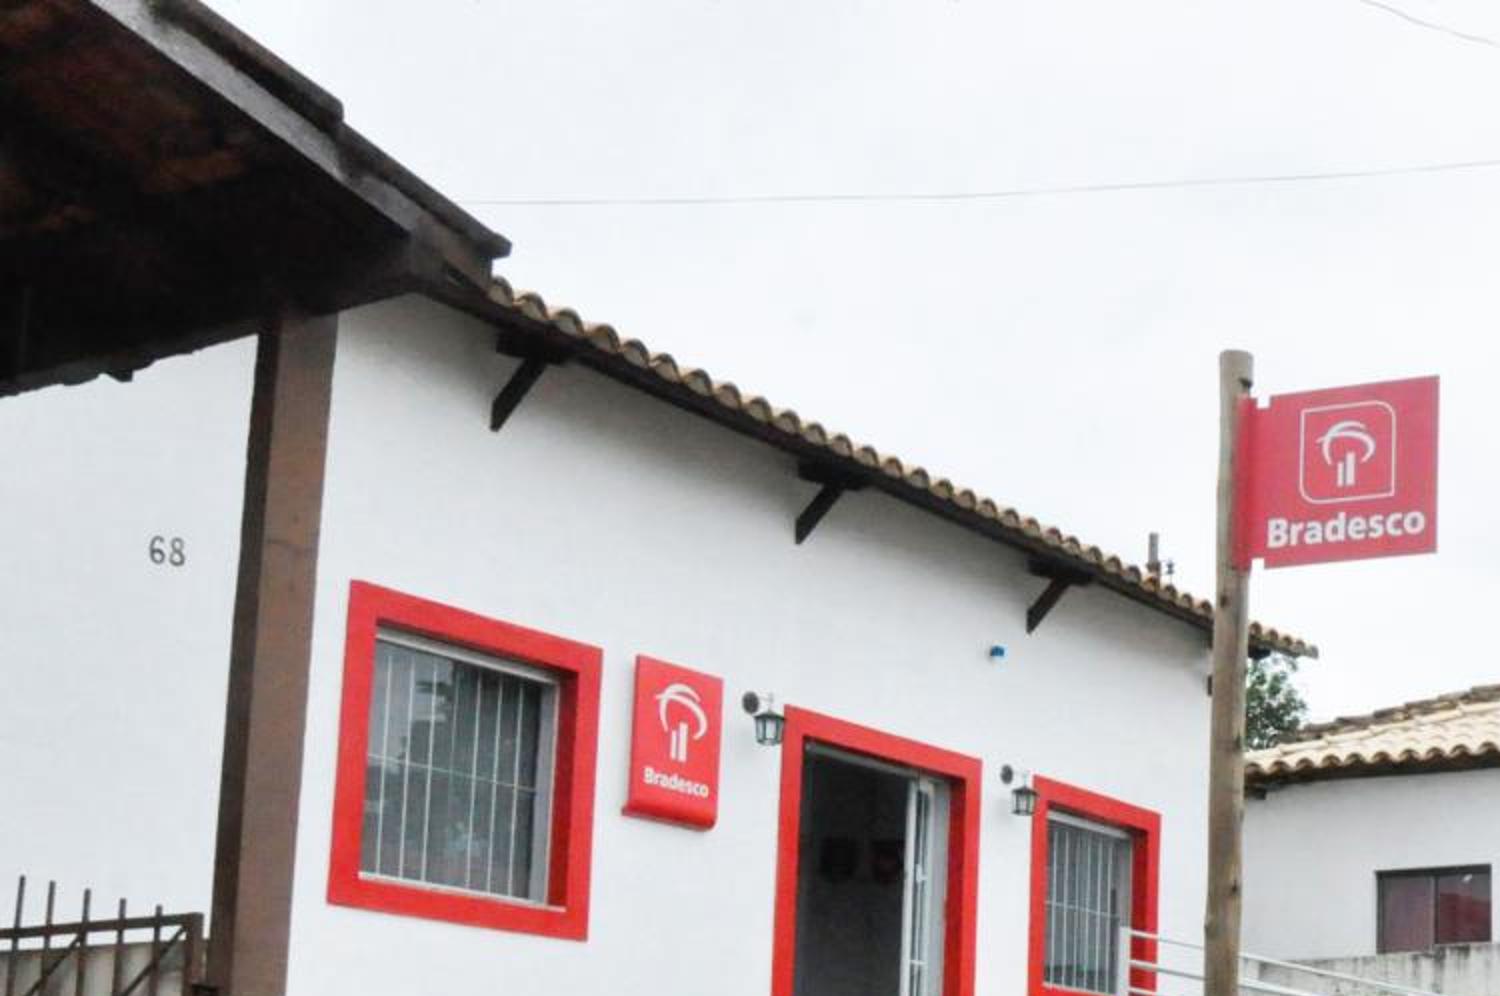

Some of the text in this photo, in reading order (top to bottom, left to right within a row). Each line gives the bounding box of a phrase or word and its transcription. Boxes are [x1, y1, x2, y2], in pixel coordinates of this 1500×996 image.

[1267, 511, 1425, 548] Bradesco
[150, 535, 185, 567] 68
[643, 766, 709, 799] Bradesco
